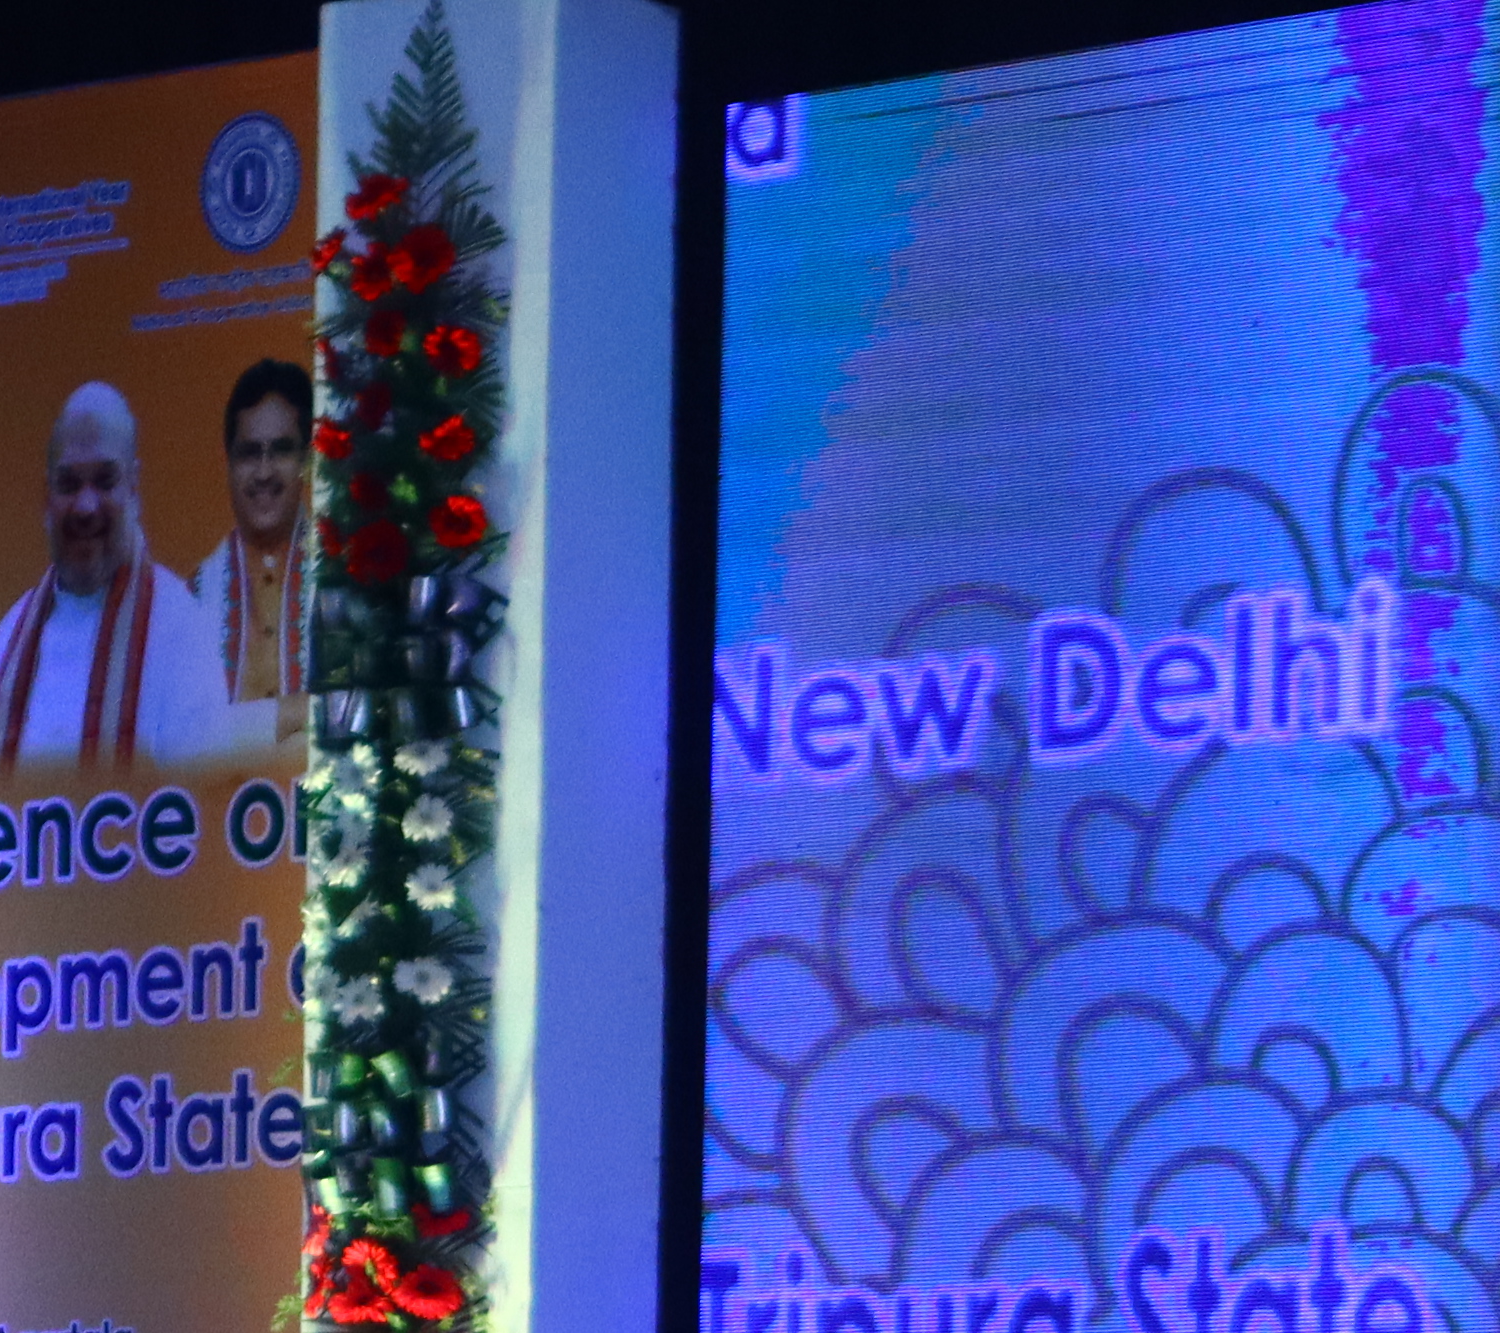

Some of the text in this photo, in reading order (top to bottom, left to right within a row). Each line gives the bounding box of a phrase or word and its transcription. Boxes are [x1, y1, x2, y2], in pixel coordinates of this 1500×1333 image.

[713, 586, 1382, 773] New Delhi
[105, 1074, 304, 1174] State
